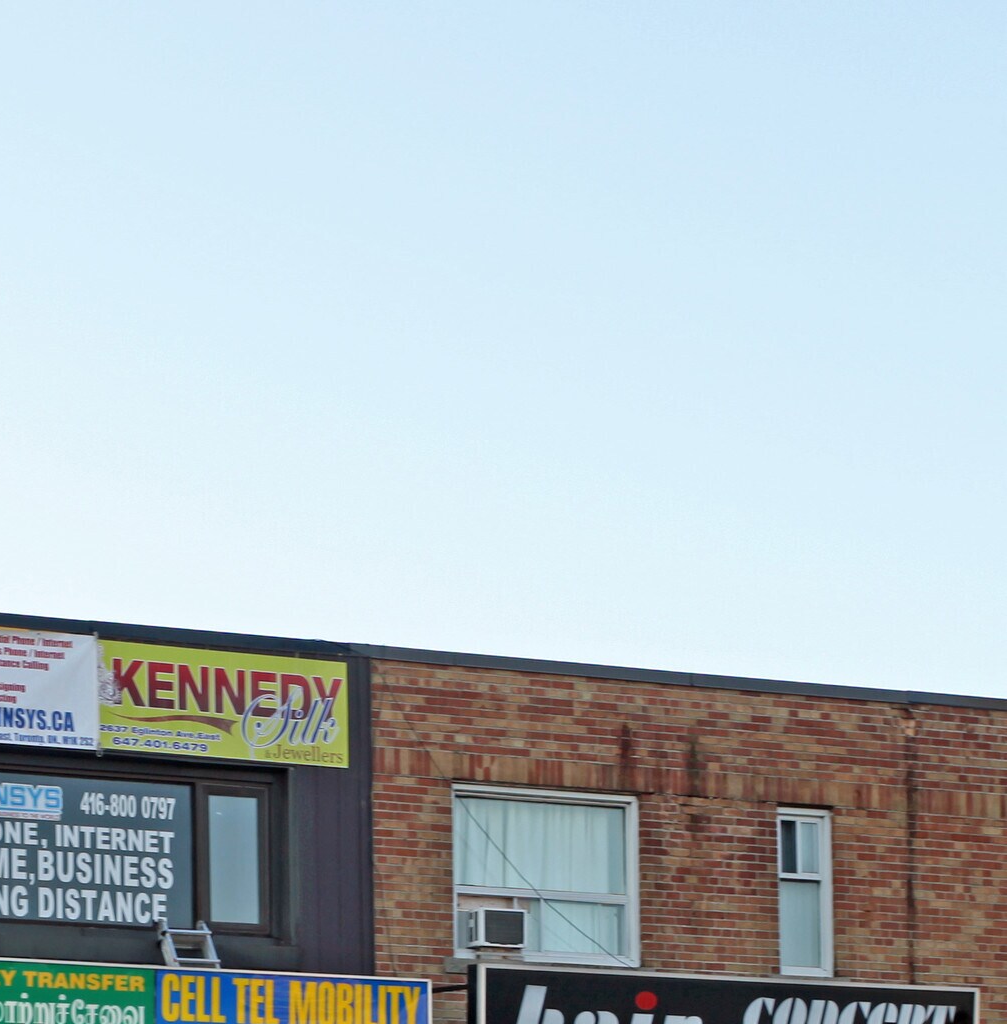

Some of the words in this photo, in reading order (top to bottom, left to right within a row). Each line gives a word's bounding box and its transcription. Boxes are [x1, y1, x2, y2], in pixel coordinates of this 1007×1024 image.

[113, 658, 343, 721] KENNEDY
[242, 686, 339, 750] Silk
[112, 737, 208, 753] 647.401.6479
[273, 744, 343, 764] Jewellers
[80, 792, 136, 818] 416-800
[141, 795, 176, 820] 0797
[55, 824, 174, 853] INTERNET
[37, 887, 168, 924] DISTANCE
[23, 970, 146, 992] TRANSFER
[161, 973, 226, 1024] CELL
